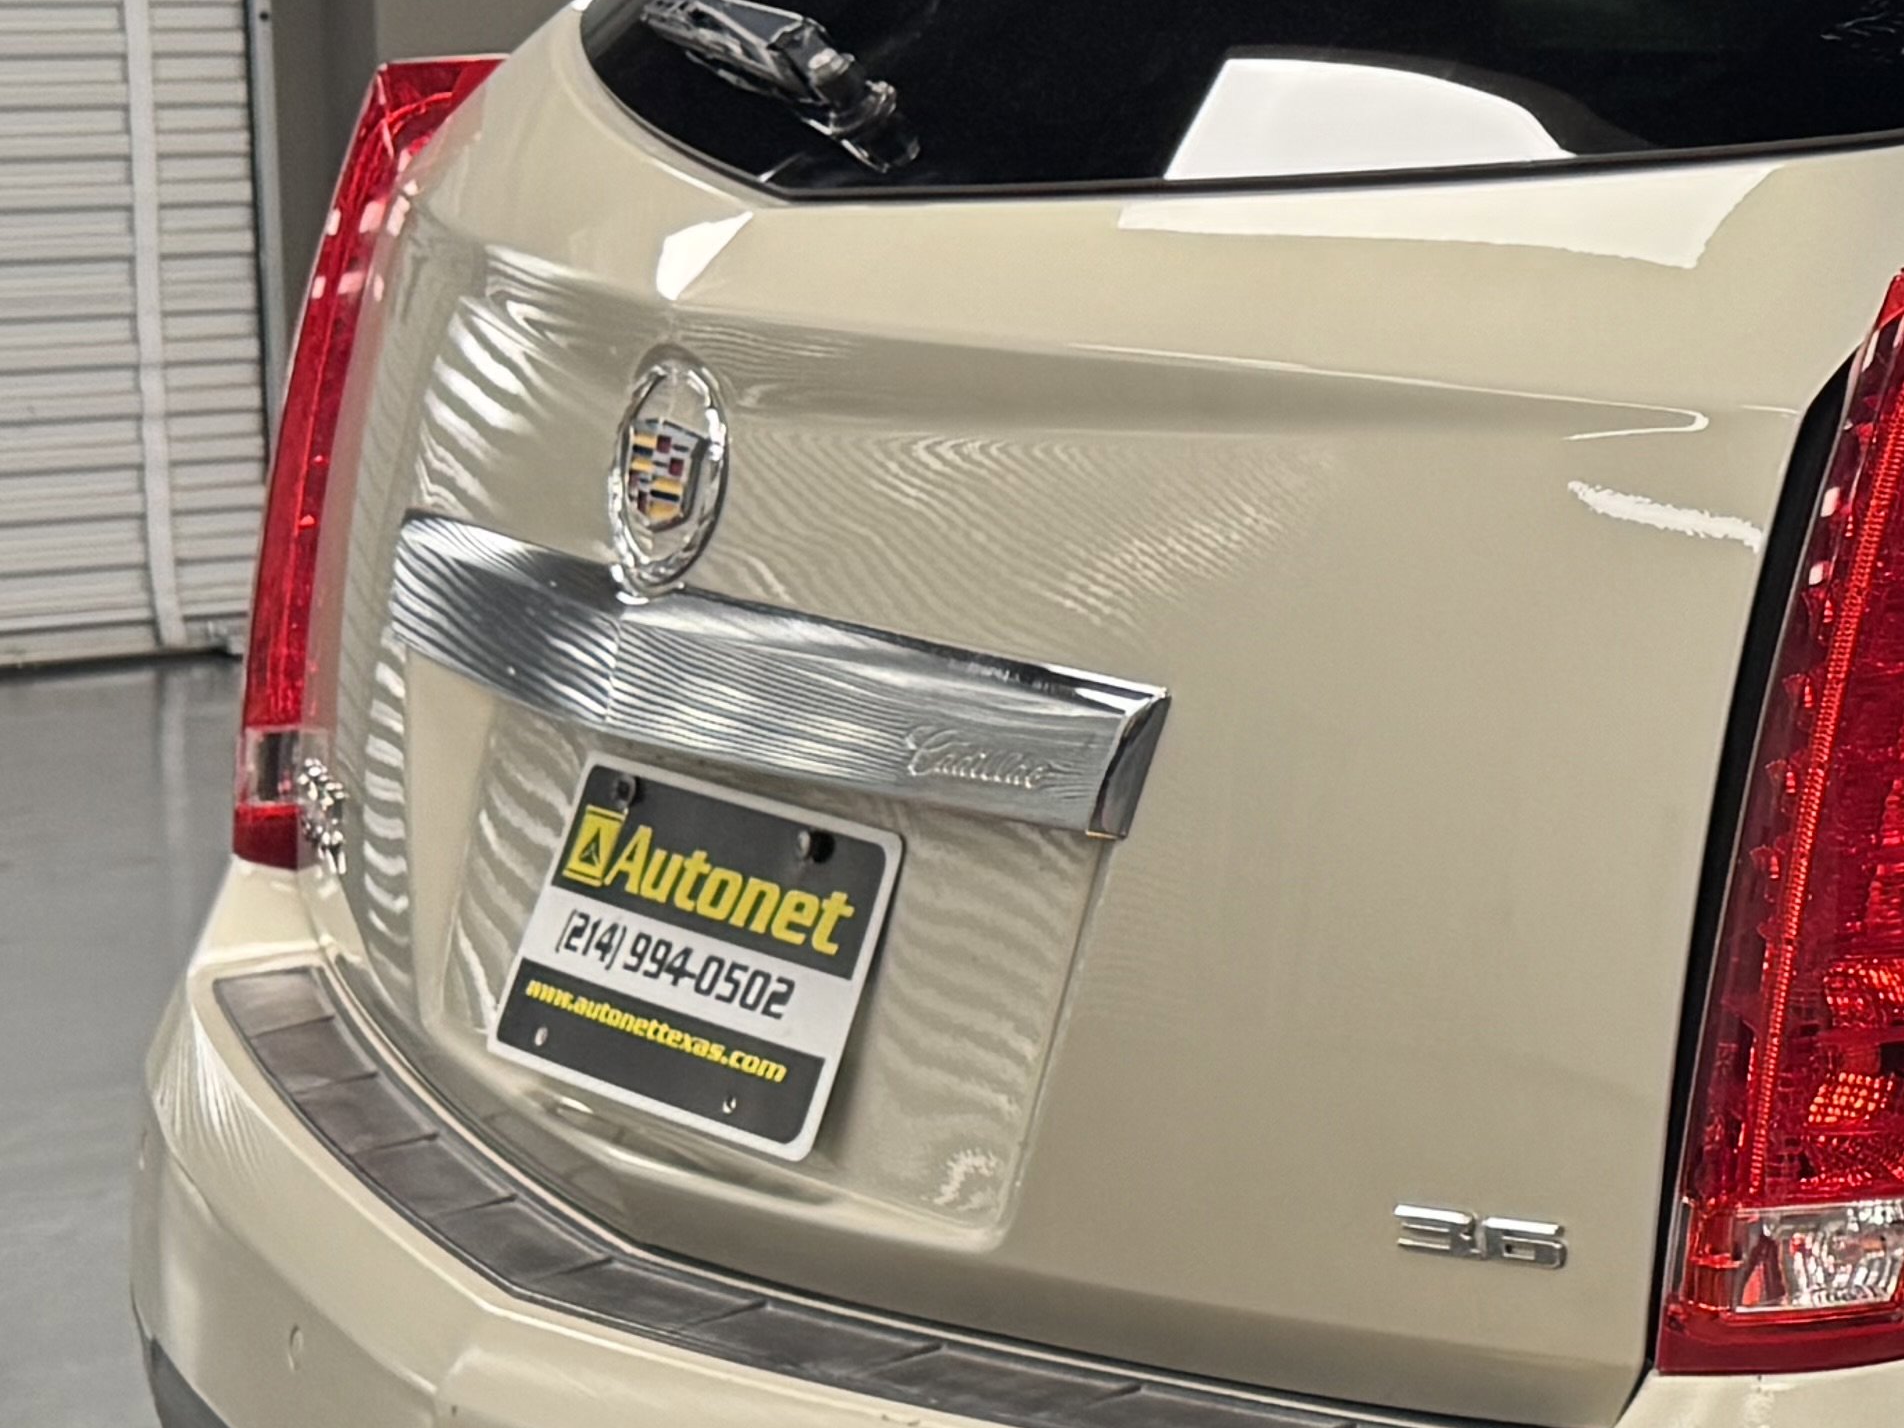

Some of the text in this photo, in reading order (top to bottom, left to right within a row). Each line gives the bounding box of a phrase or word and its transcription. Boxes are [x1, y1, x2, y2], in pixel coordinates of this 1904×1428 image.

[604, 825, 854, 956] Autonet
[555, 910, 796, 1020] (214) 994-0502
[525, 978, 788, 1083] www.autonettexas.com
